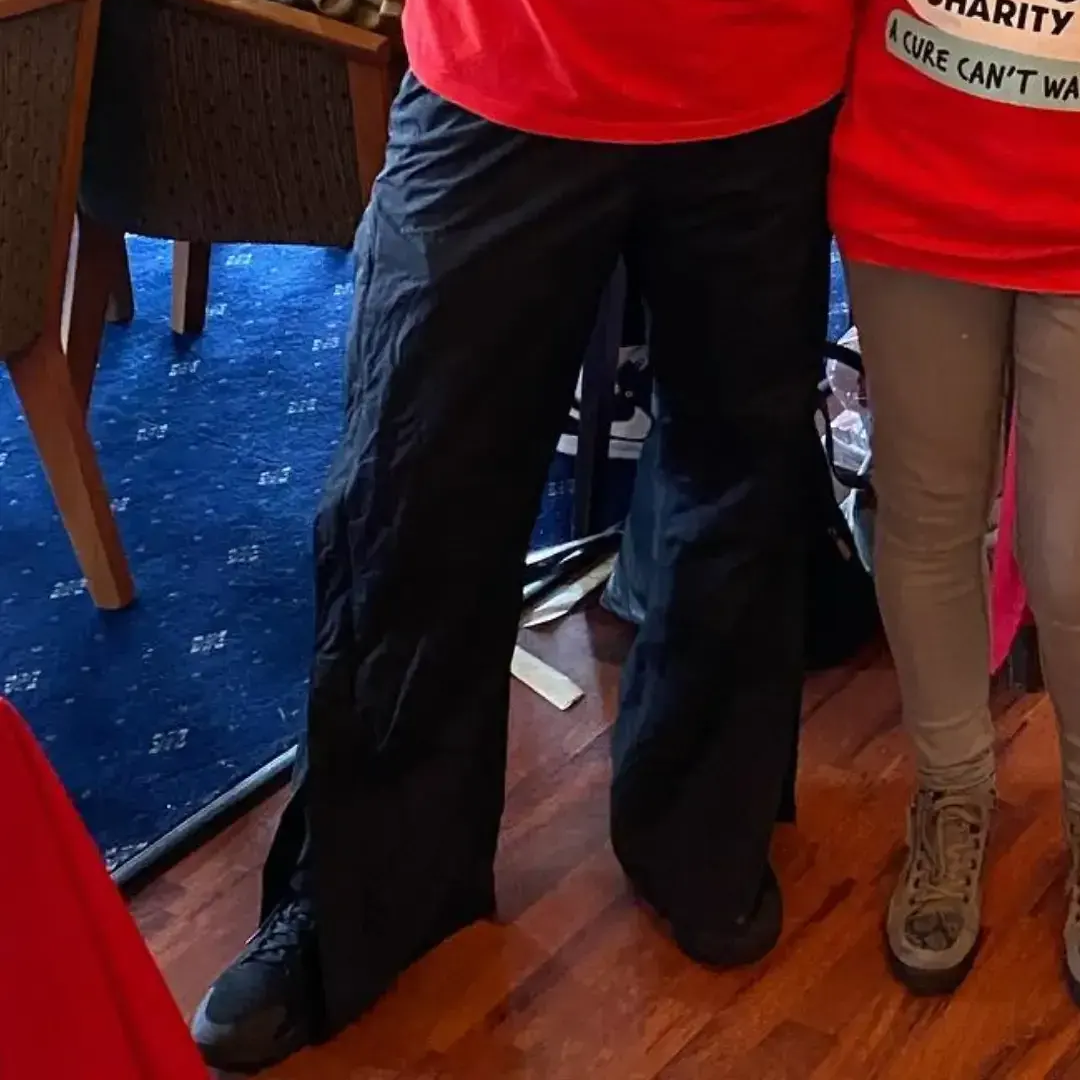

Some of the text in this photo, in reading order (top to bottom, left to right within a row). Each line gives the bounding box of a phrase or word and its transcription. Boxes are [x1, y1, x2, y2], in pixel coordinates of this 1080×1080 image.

[889, 17, 898, 41] A
[903, 30, 949, 72] CURE
[957, 57, 1037, 95] CAN'T
